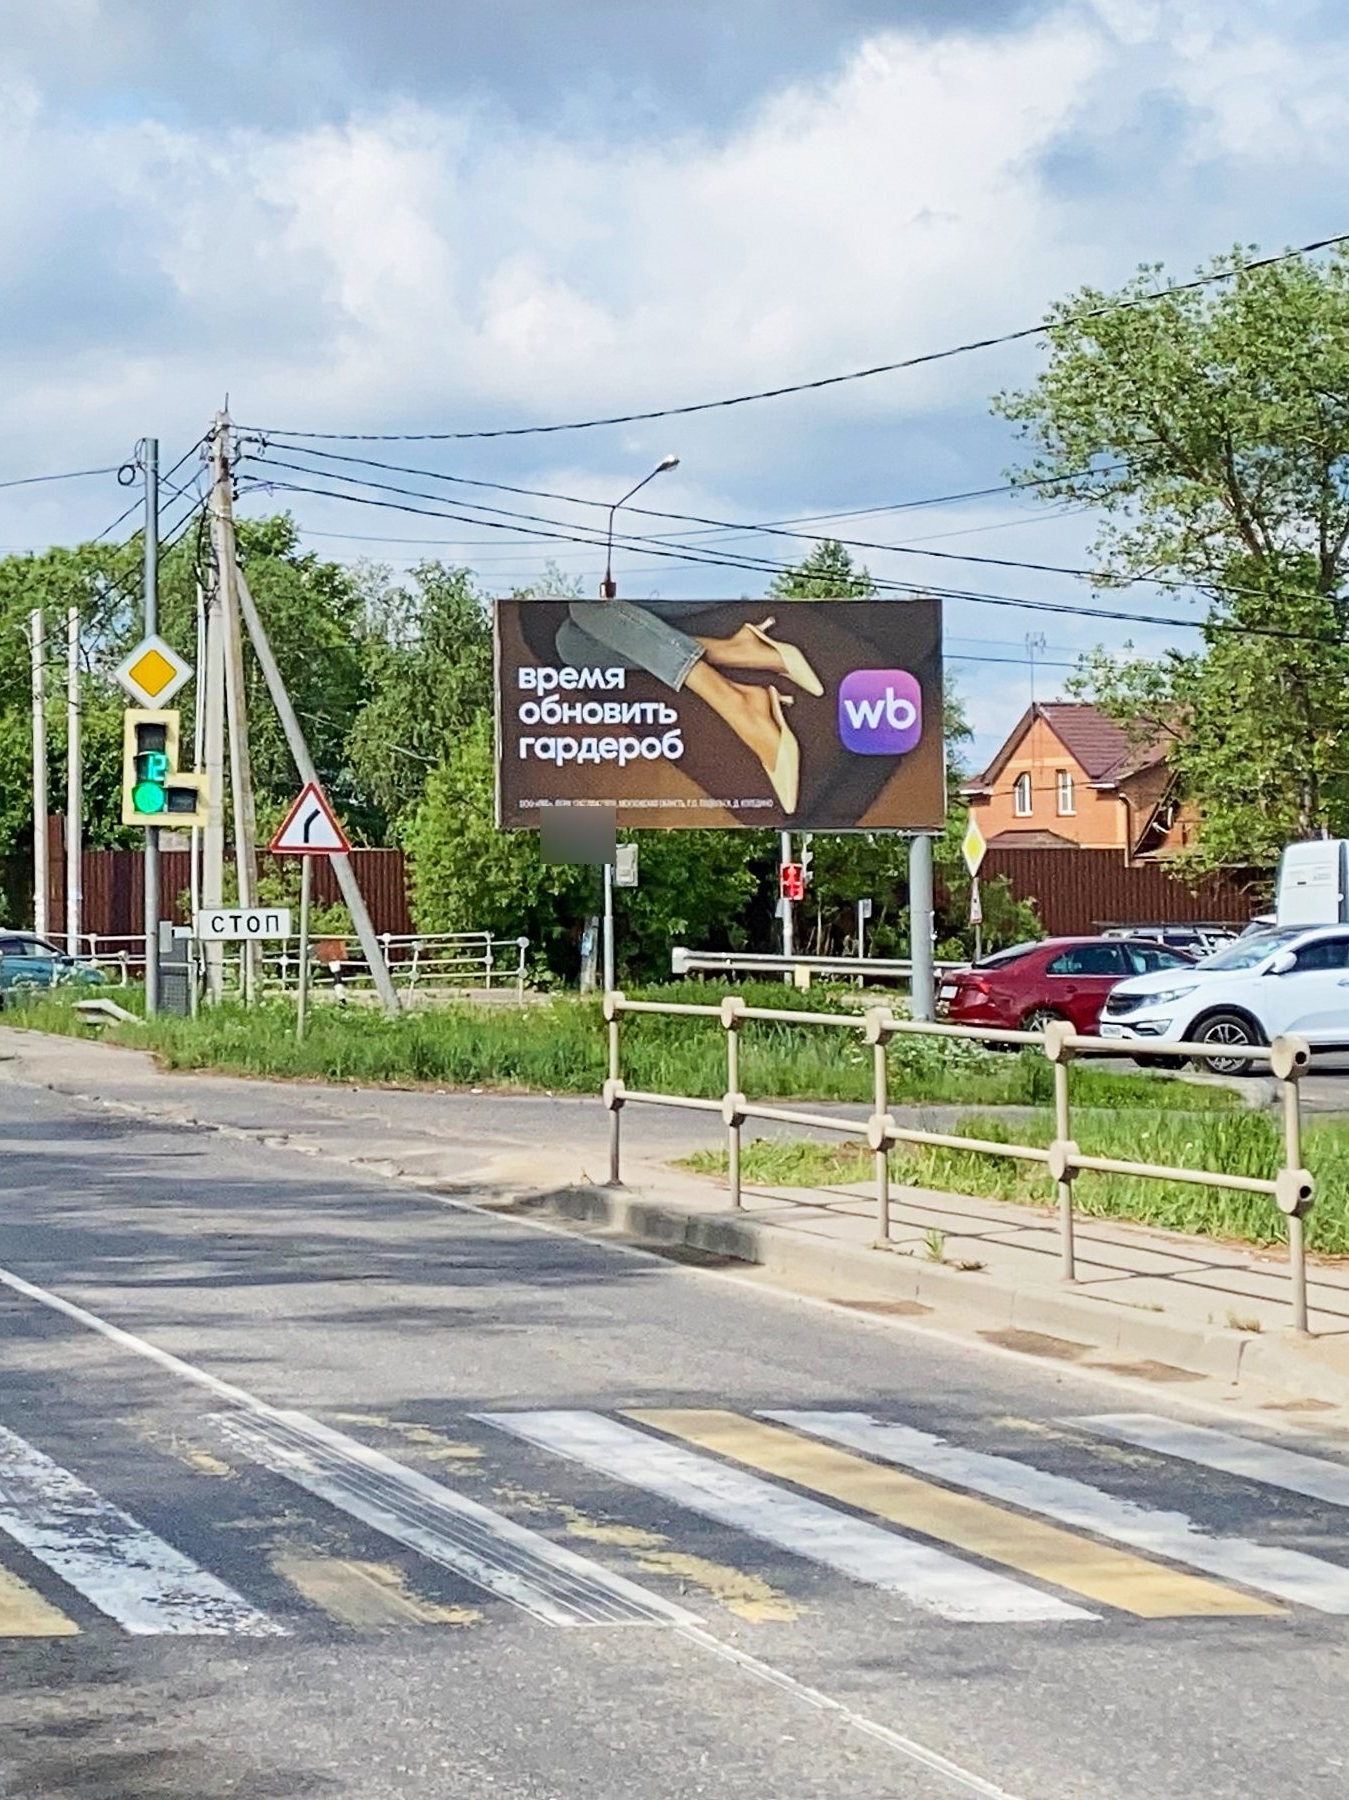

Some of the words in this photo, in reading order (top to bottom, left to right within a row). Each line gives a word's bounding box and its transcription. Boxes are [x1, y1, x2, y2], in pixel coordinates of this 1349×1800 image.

[518, 666, 626, 694] время
[518, 695, 678, 725] обновить
[843, 686, 917, 731] wb
[519, 728, 685, 767] гардероб
[211, 915, 279, 933] СТОП
